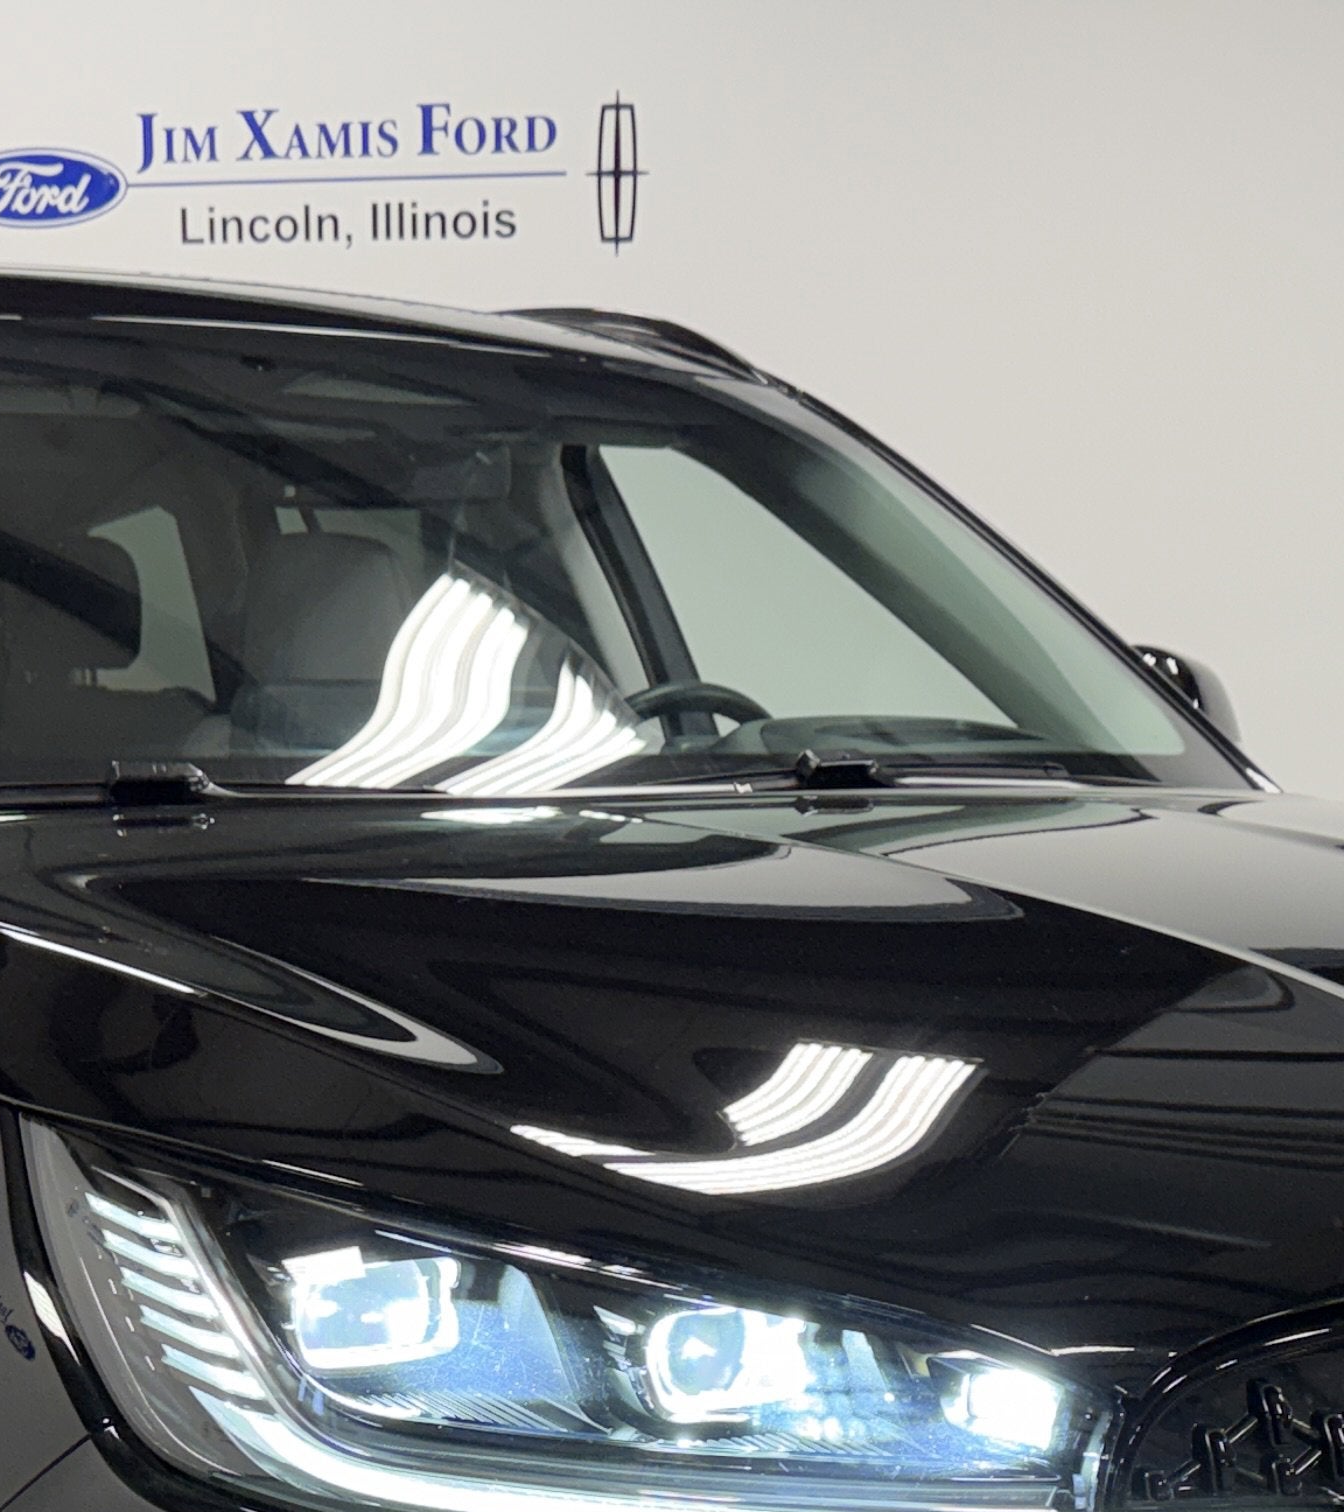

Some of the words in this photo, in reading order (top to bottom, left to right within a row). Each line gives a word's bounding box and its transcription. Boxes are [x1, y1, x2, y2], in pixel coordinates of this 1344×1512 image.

[137, 112, 218, 173] JIM
[237, 109, 399, 161] XAMIS
[417, 103, 557, 156] FORD
[180, 204, 354, 250] Lincoln,
[371, 199, 517, 241] Illinois
